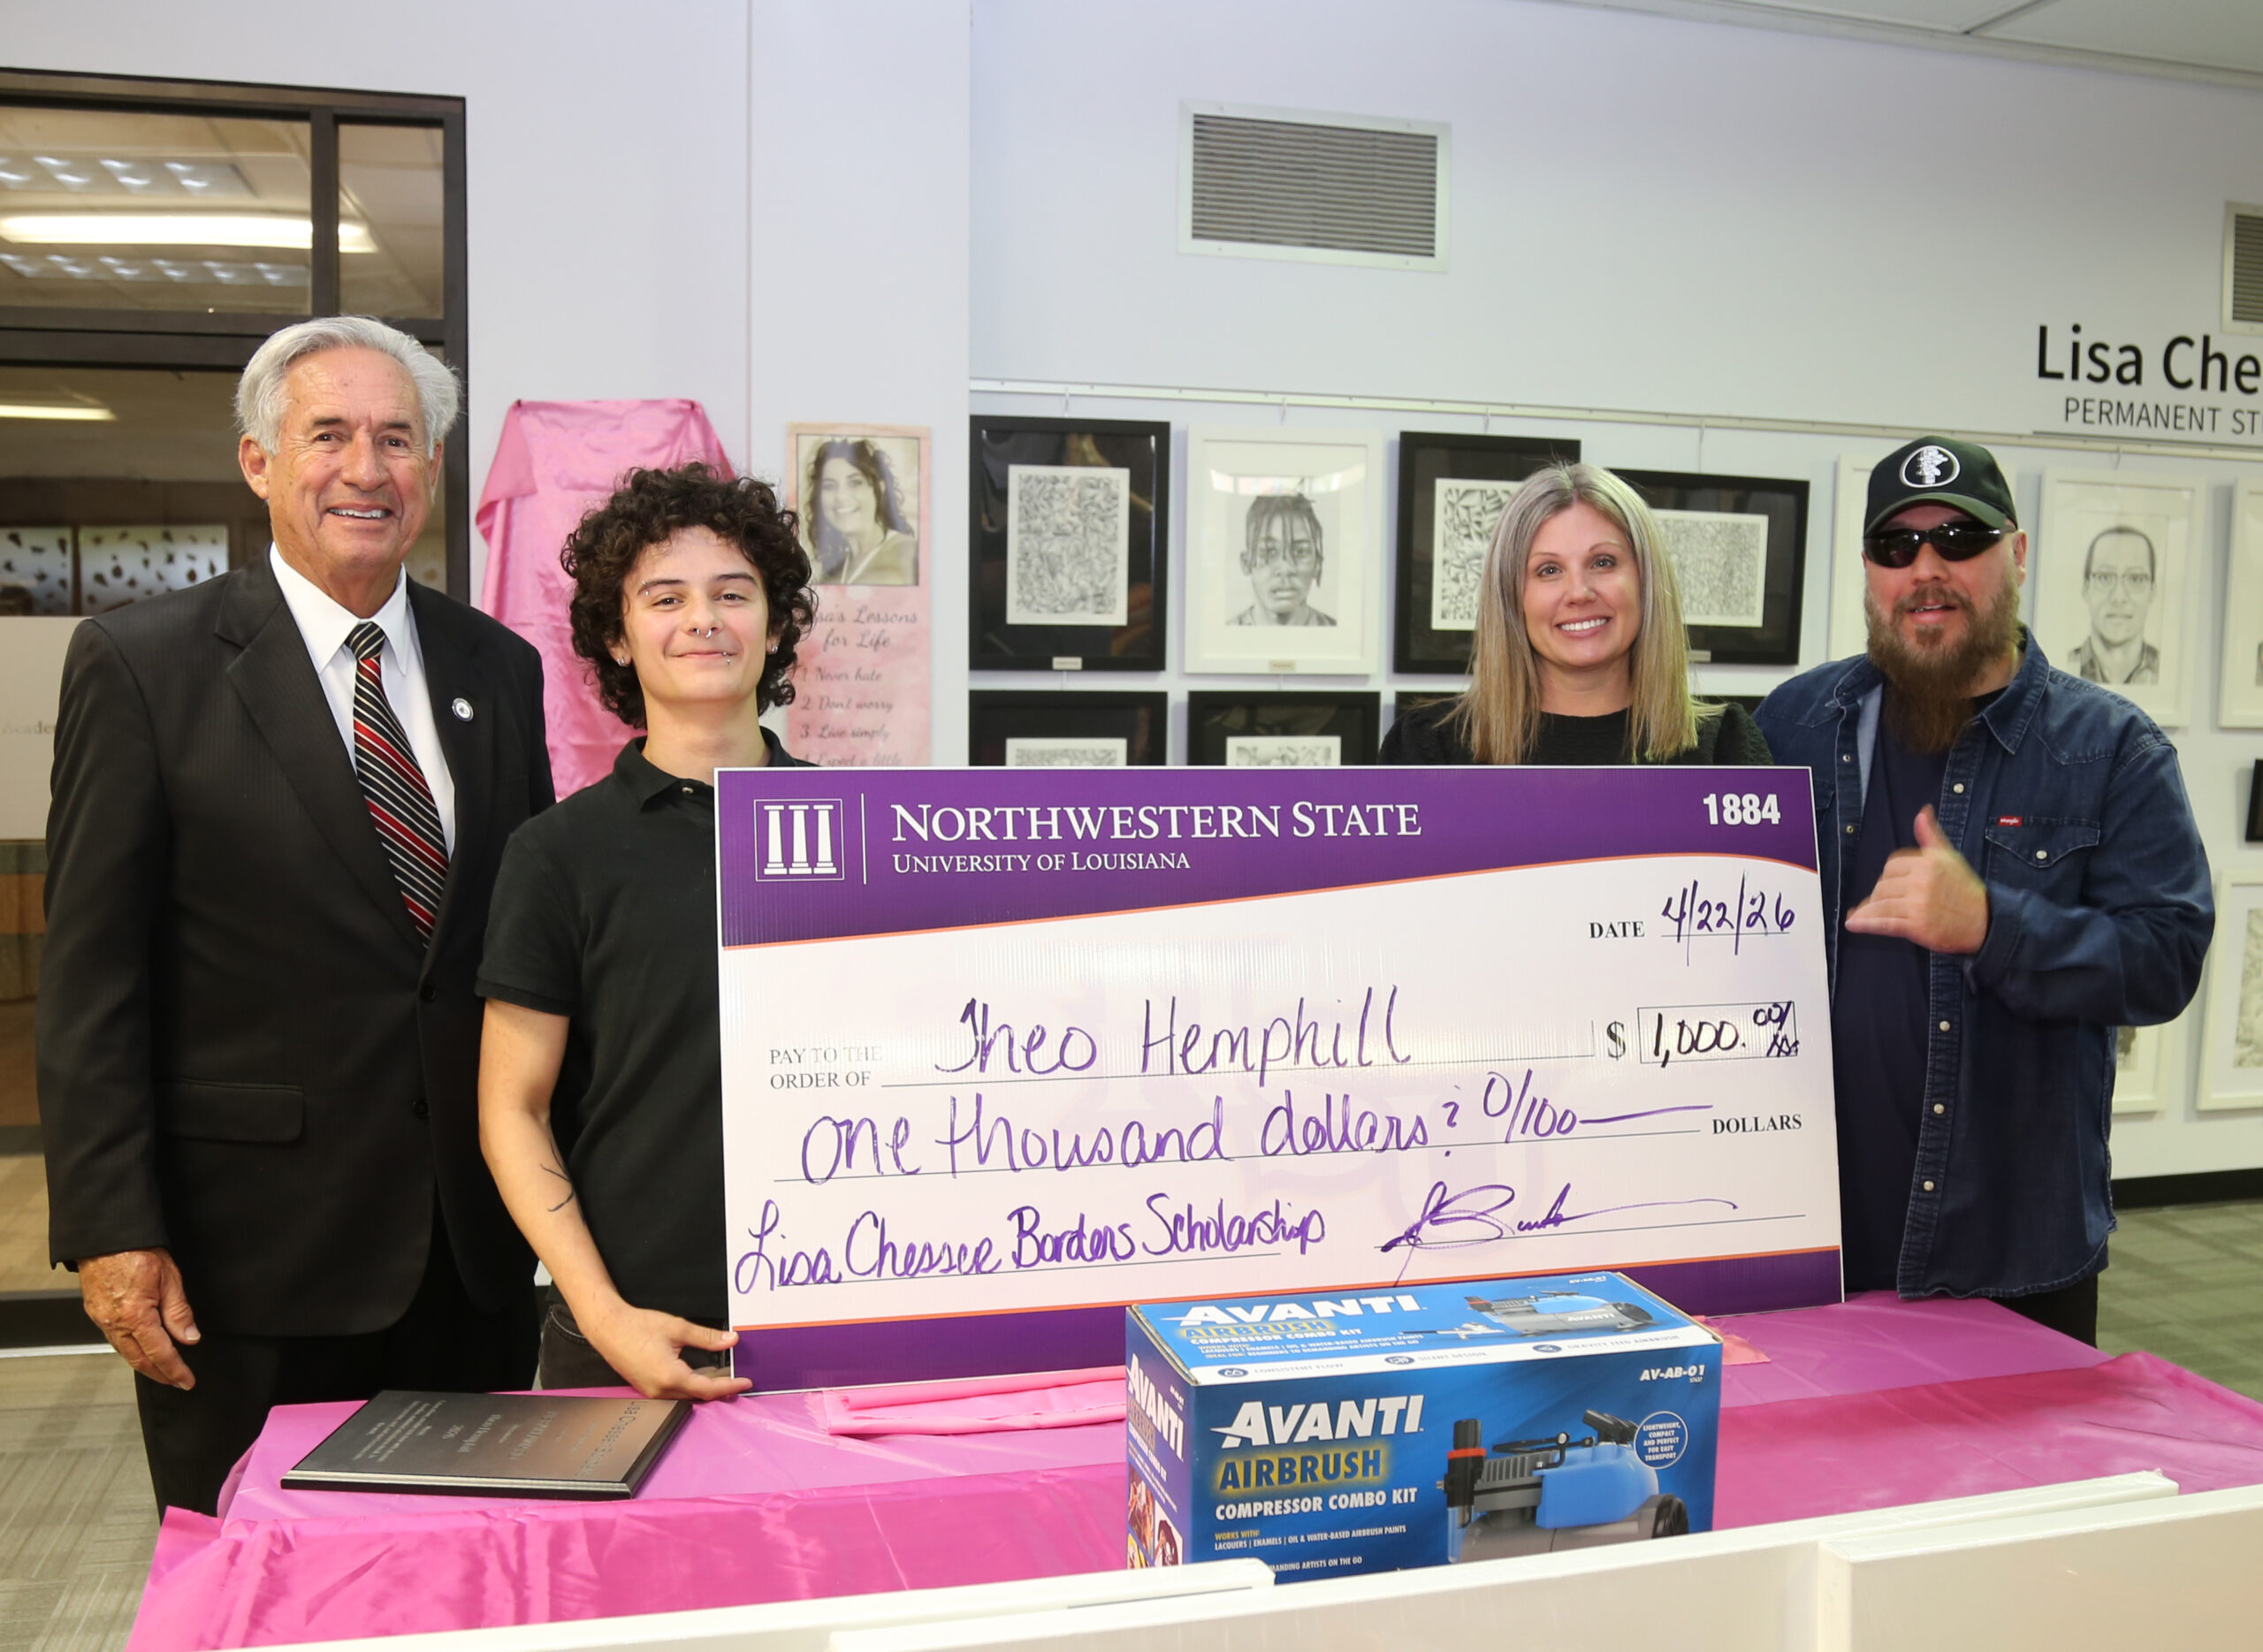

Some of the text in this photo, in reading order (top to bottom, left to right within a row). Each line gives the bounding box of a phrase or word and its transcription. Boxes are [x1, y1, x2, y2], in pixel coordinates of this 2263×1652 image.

[2038, 324, 2262, 395] Lisa Che
[2064, 396, 2263, 436] PERMANENT ST
[854, 605, 918, 624] Lessons
[823, 628, 891, 652] for Life
[890, 800, 1422, 842] NORTHWESTERN STATE
[1703, 793, 1782, 826] 1884
[893, 851, 1191, 873] UNIVERSITY OF LOUISIANA
[1589, 920, 1645, 939] DATE
[1662, 870, 1795, 966] 4/22/26
[934, 985, 1412, 1087] Theo Hemphill
[1606, 1021, 1627, 1062] $
[769, 1046, 882, 1065] PAY TO THE
[770, 1071, 872, 1090] ORDER OF
[934, 1092, 1236, 1179] thousand
[1261, 1090, 1429, 1156] dollars
[1712, 1114, 1802, 1135] DOLLARS
[735, 1199, 842, 1295] Lisa
[1142, 1192, 1326, 1256] Scholarship
[1160, 1294, 1421, 1327] AVANTI
[1567, 1313, 1616, 1322] AVANTI
[1185, 1319, 1331, 1339] AIRBRUSH
[1190, 1328, 1363, 1345] COMPRESSOR COMBO KIT
[1640, 1364, 1706, 1382] AV-AB-01
[1127, 1353, 1184, 1462] AVANTI
[1209, 1395, 1424, 1449] AVANTI
[1649, 1430, 1675, 1439] COMPACT
[1657, 1436, 1680, 1445] PERFECT
[1645, 1452, 1677, 1462] TRANSPORT
[1219, 1449, 1383, 1490] AIRBRUSH
[1215, 1487, 1419, 1521] COMPRESSOR COMBO KIT
[1215, 1529, 1261, 1542] WORKS WITH:
[1215, 1540, 1247, 1551] LACQUERS
[1253, 1536, 1283, 1548] ENAMELS
[1288, 1534, 1299, 1544] OIL
[1299, 1534, 1306, 1543] &
[1307, 1531, 1351, 1542] WATER-BASED
[1351, 1527, 1384, 1539] AIRBRUSH
[1384, 1525, 1407, 1535] PAINTS
[1301, 1557, 1328, 1570] ARTISTS
[1329, 1557, 1339, 1567] ON
[1339, 1557, 1352, 1566] THE
[1352, 1555, 1363, 1564] GO
